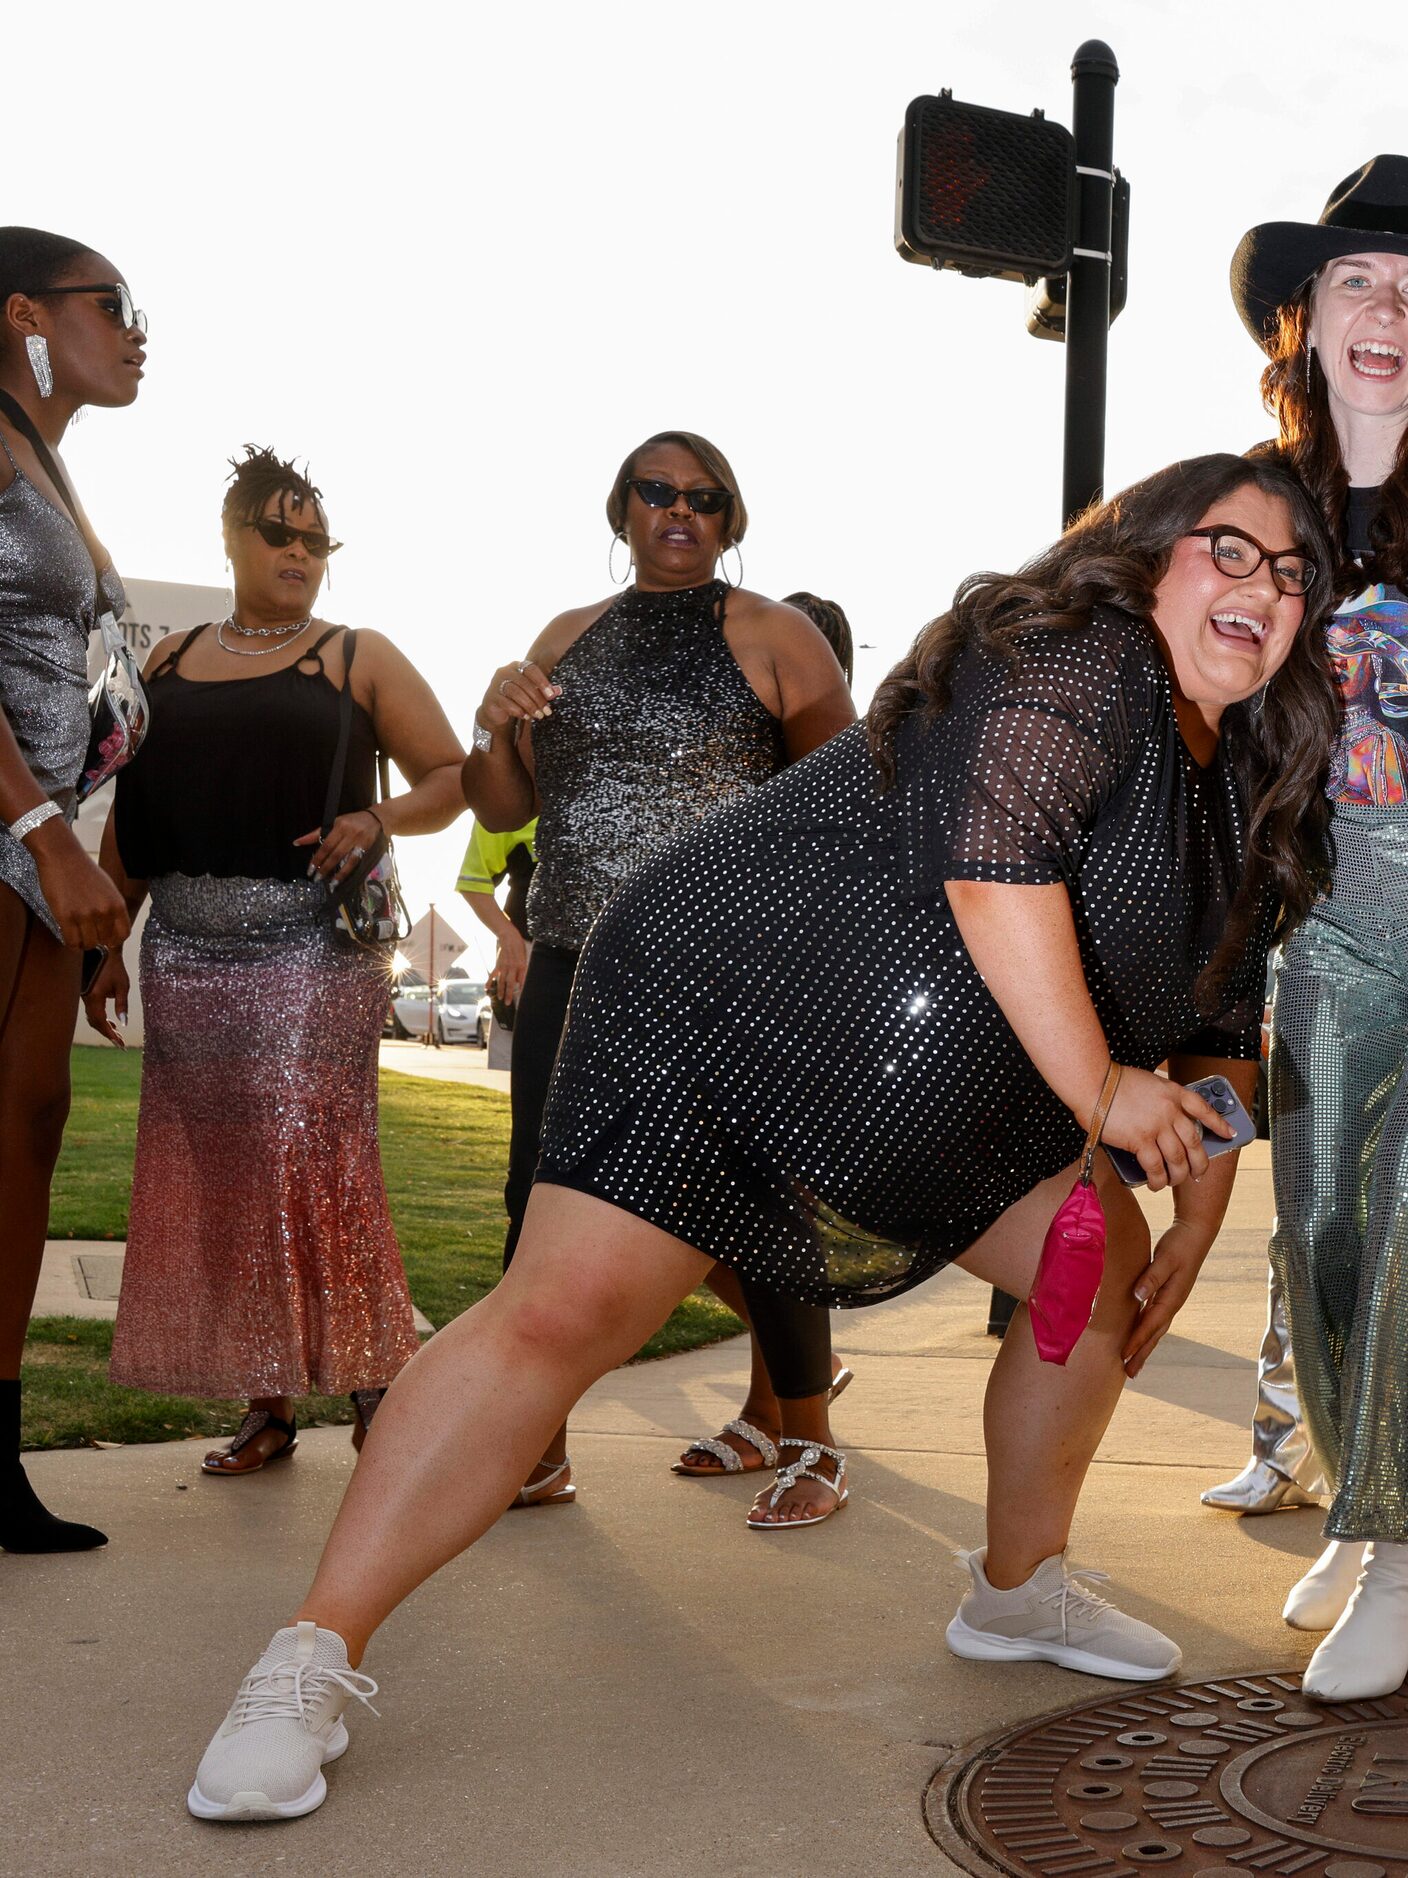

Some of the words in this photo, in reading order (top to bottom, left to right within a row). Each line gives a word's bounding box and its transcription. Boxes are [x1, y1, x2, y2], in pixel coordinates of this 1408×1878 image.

[116, 622, 151, 649] OTS
[1320, 1736, 1367, 1774] Electric
[1287, 1776, 1345, 1825] Delivery
